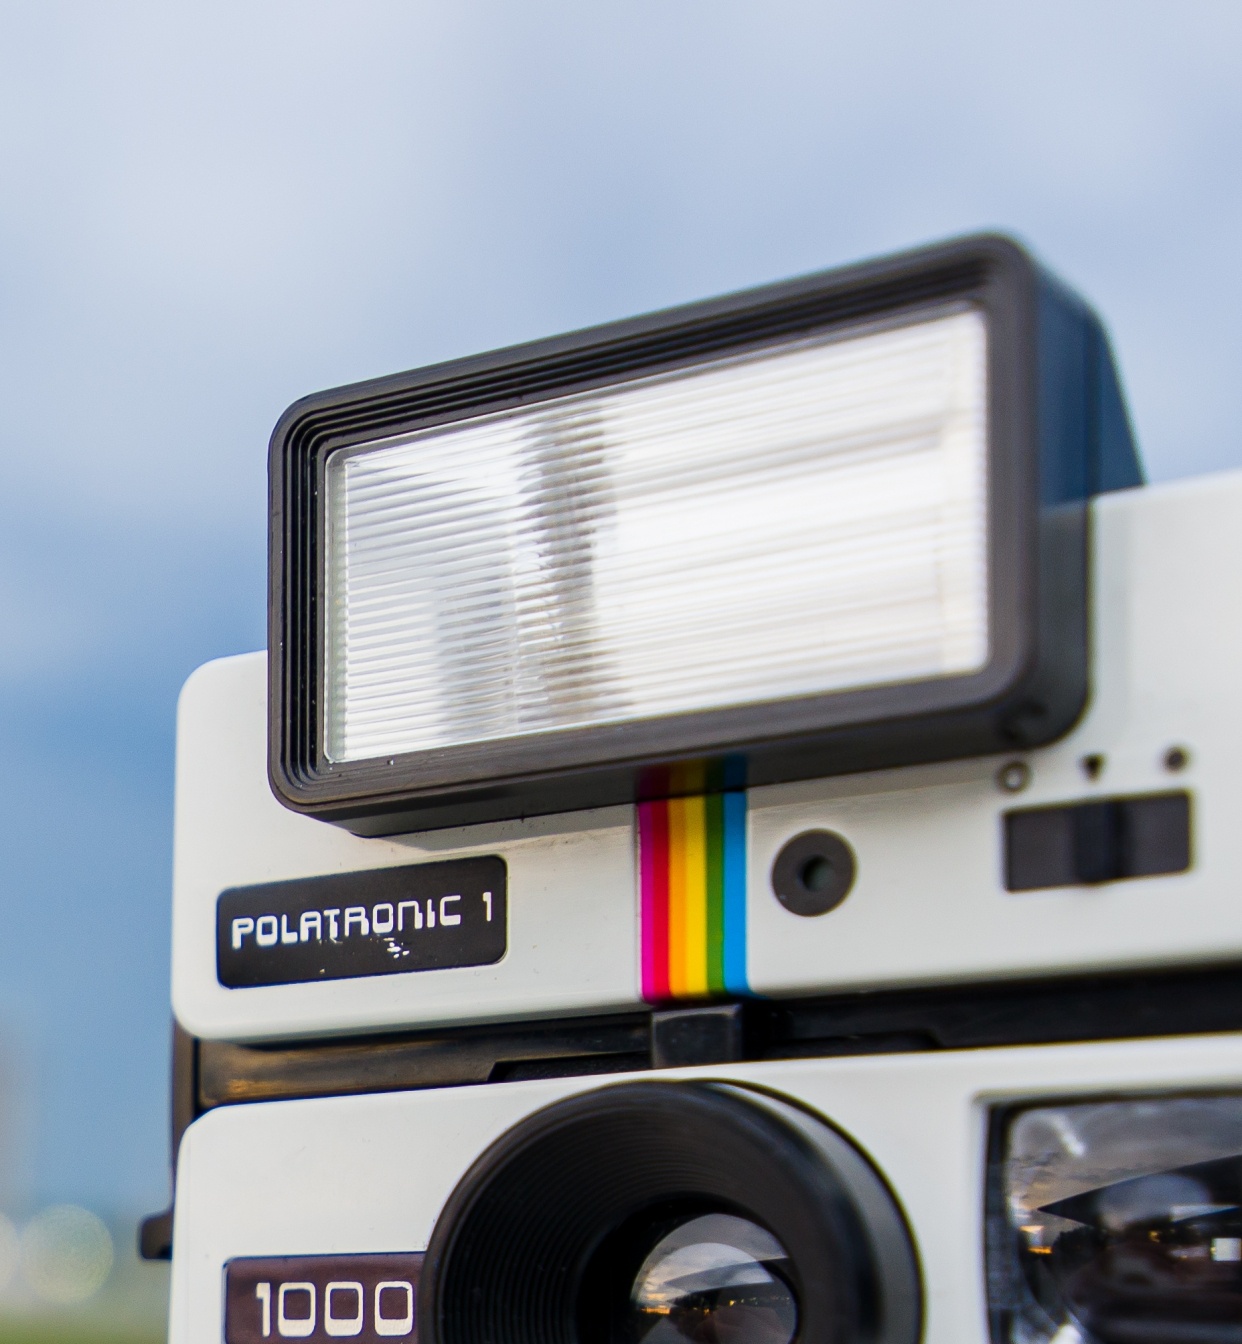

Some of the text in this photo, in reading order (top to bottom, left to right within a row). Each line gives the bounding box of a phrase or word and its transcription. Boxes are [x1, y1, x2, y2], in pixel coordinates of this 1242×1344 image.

[231, 891, 492, 950] POLATRONIC 1
[255, 1280, 414, 1338] 1000
